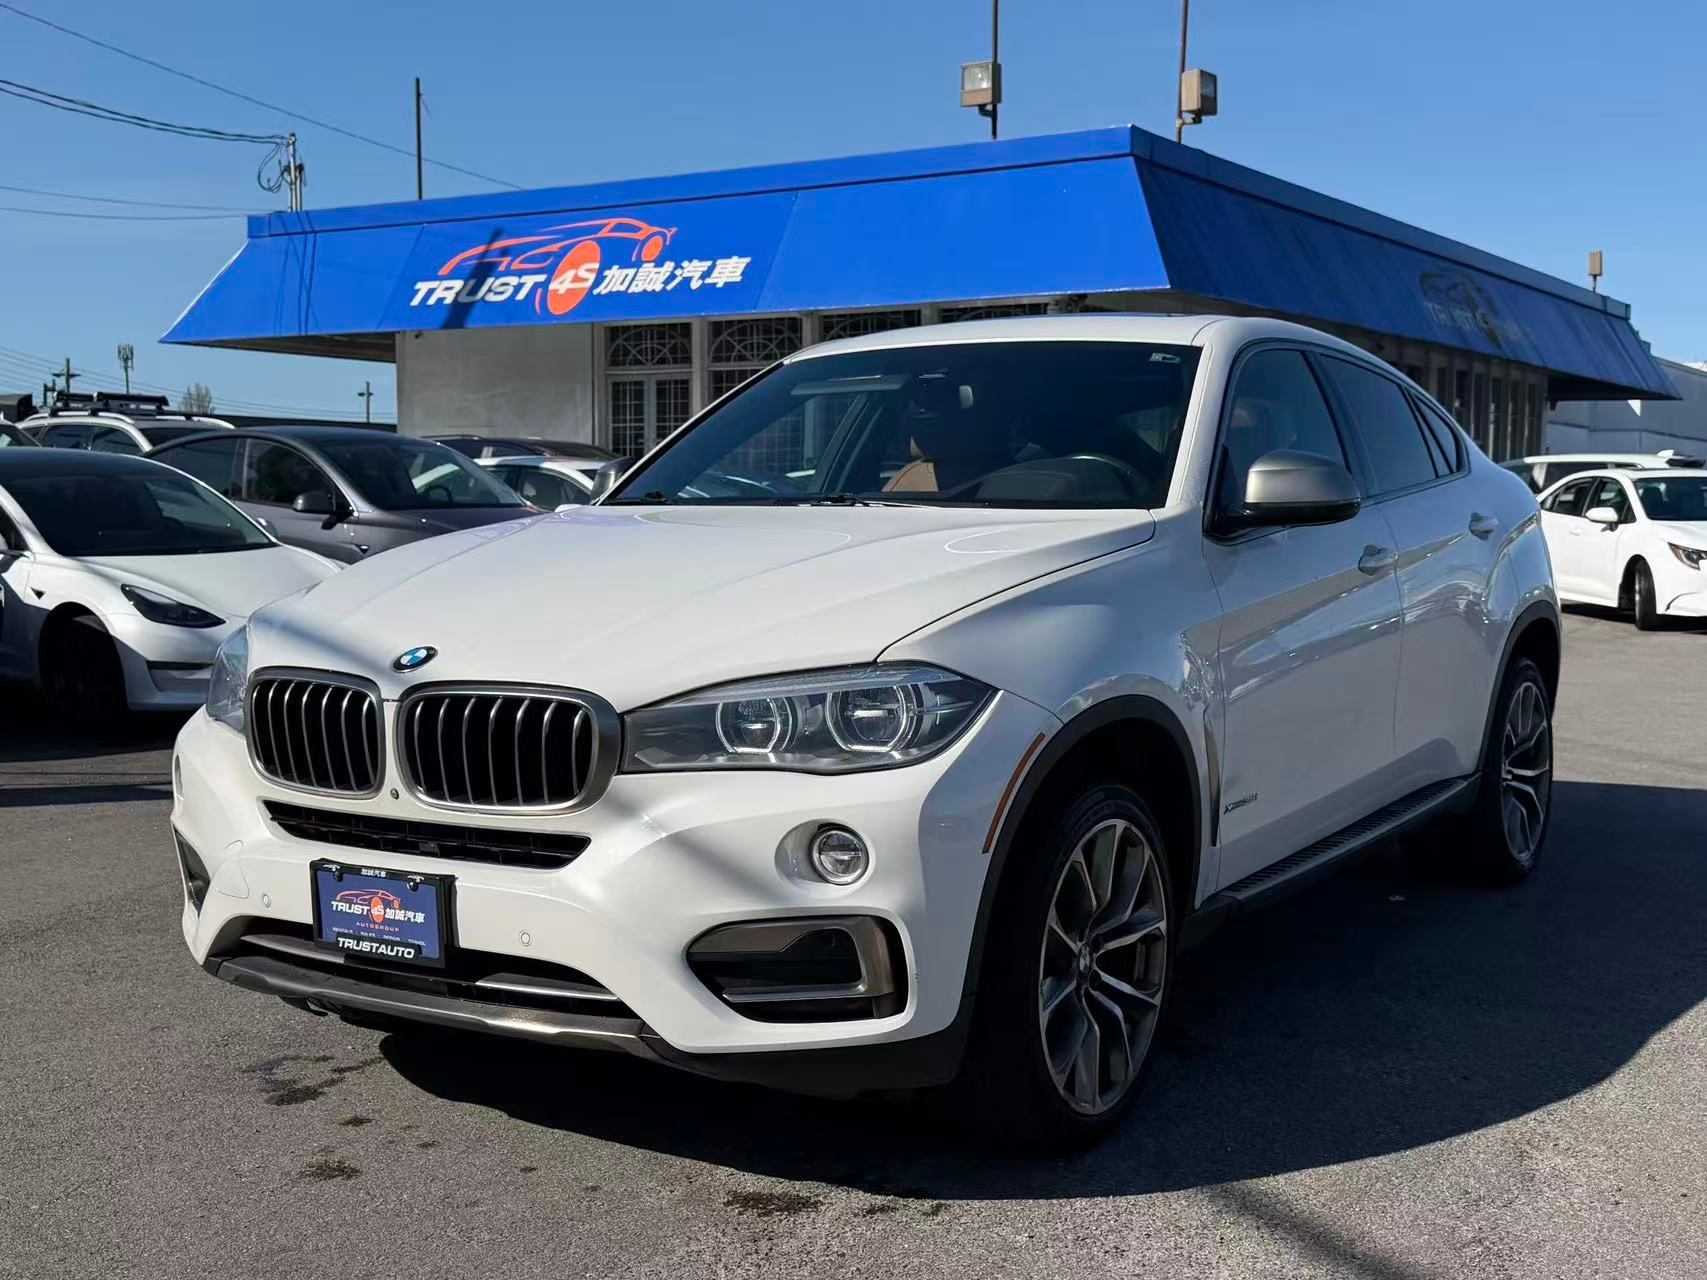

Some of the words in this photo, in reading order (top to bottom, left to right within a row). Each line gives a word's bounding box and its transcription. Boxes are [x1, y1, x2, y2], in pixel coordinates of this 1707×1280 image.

[409, 273, 548, 307] TRUST
[549, 262, 600, 295] 4S
[593, 255, 751, 295] 加誠汽車
[331, 900, 370, 915] TRUST
[385, 907, 425, 923] 加誠汽車
[356, 922, 400, 931] AUTOGROUP
[337, 937, 415, 958] TRUSTAUTO
